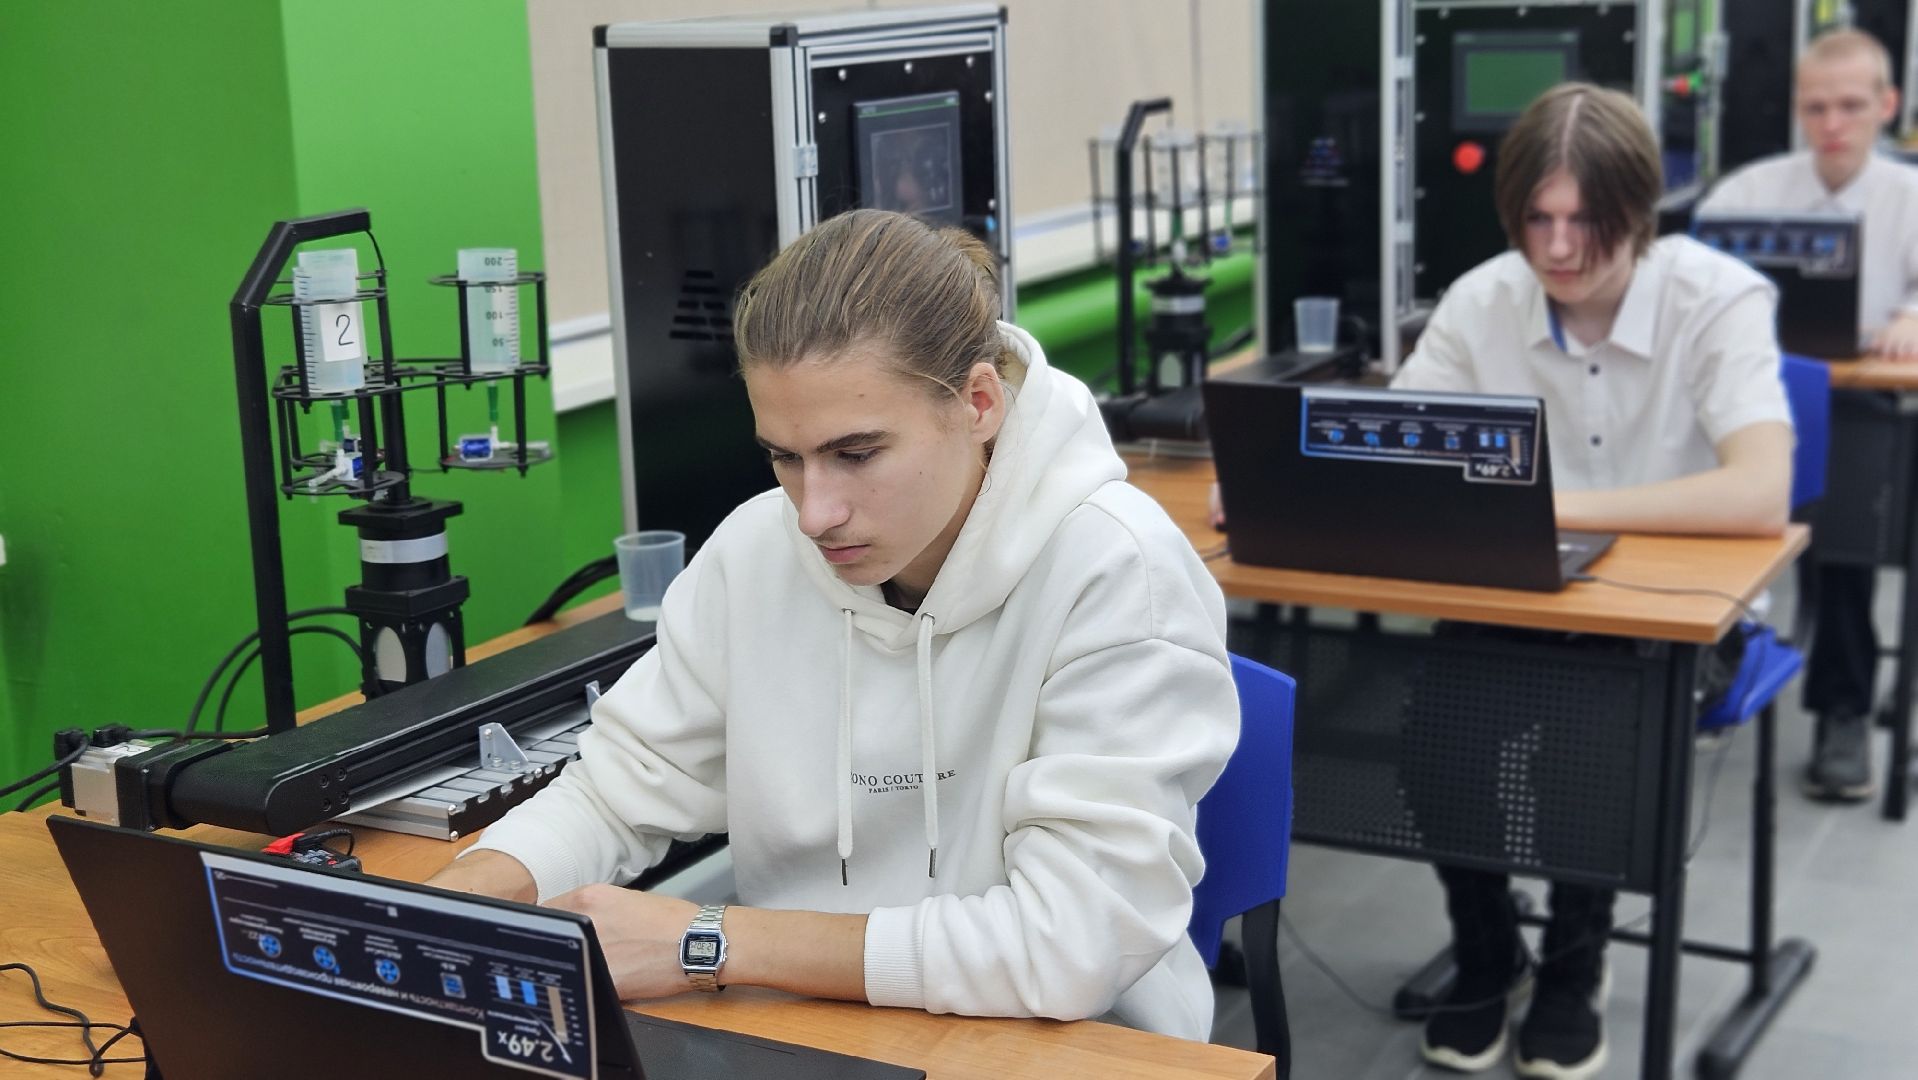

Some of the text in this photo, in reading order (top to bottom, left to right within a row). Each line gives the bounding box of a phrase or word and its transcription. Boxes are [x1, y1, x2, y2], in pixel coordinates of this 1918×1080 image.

[484, 257, 503, 267] 200
[485, 311, 503, 320] 100
[335, 314, 355, 346] 2
[850, 769, 956, 787] ONO COUTRE
[868, 786, 889, 794] PARIS
[496, 1030, 555, 1063] 2.49x
